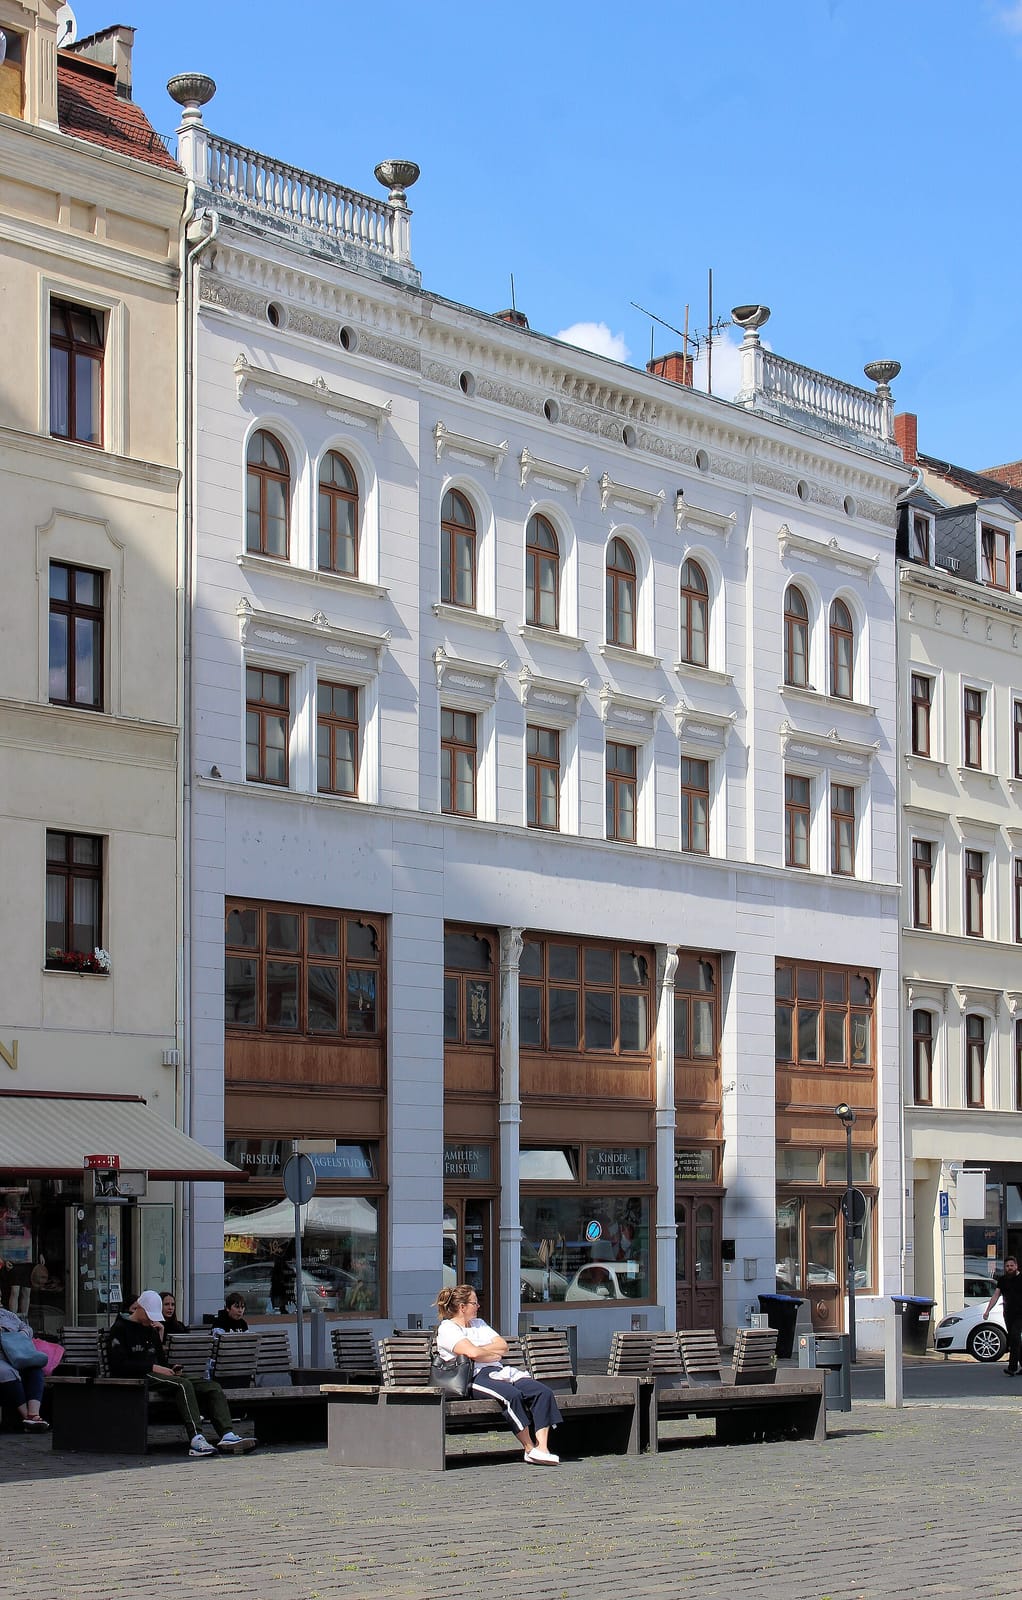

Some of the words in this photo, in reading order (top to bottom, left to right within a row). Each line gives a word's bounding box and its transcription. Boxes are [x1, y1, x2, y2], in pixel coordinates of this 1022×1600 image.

[240, 1152, 281, 1165] FRISEUR
[444, 1150, 483, 1161] AMILIEN-
[598, 1152, 632, 1163] KINDER-
[445, 1162, 479, 1174] FRISEUR
[595, 1164, 634, 1176] SPIELECKE
[941, 1195, 947, 1214] P
